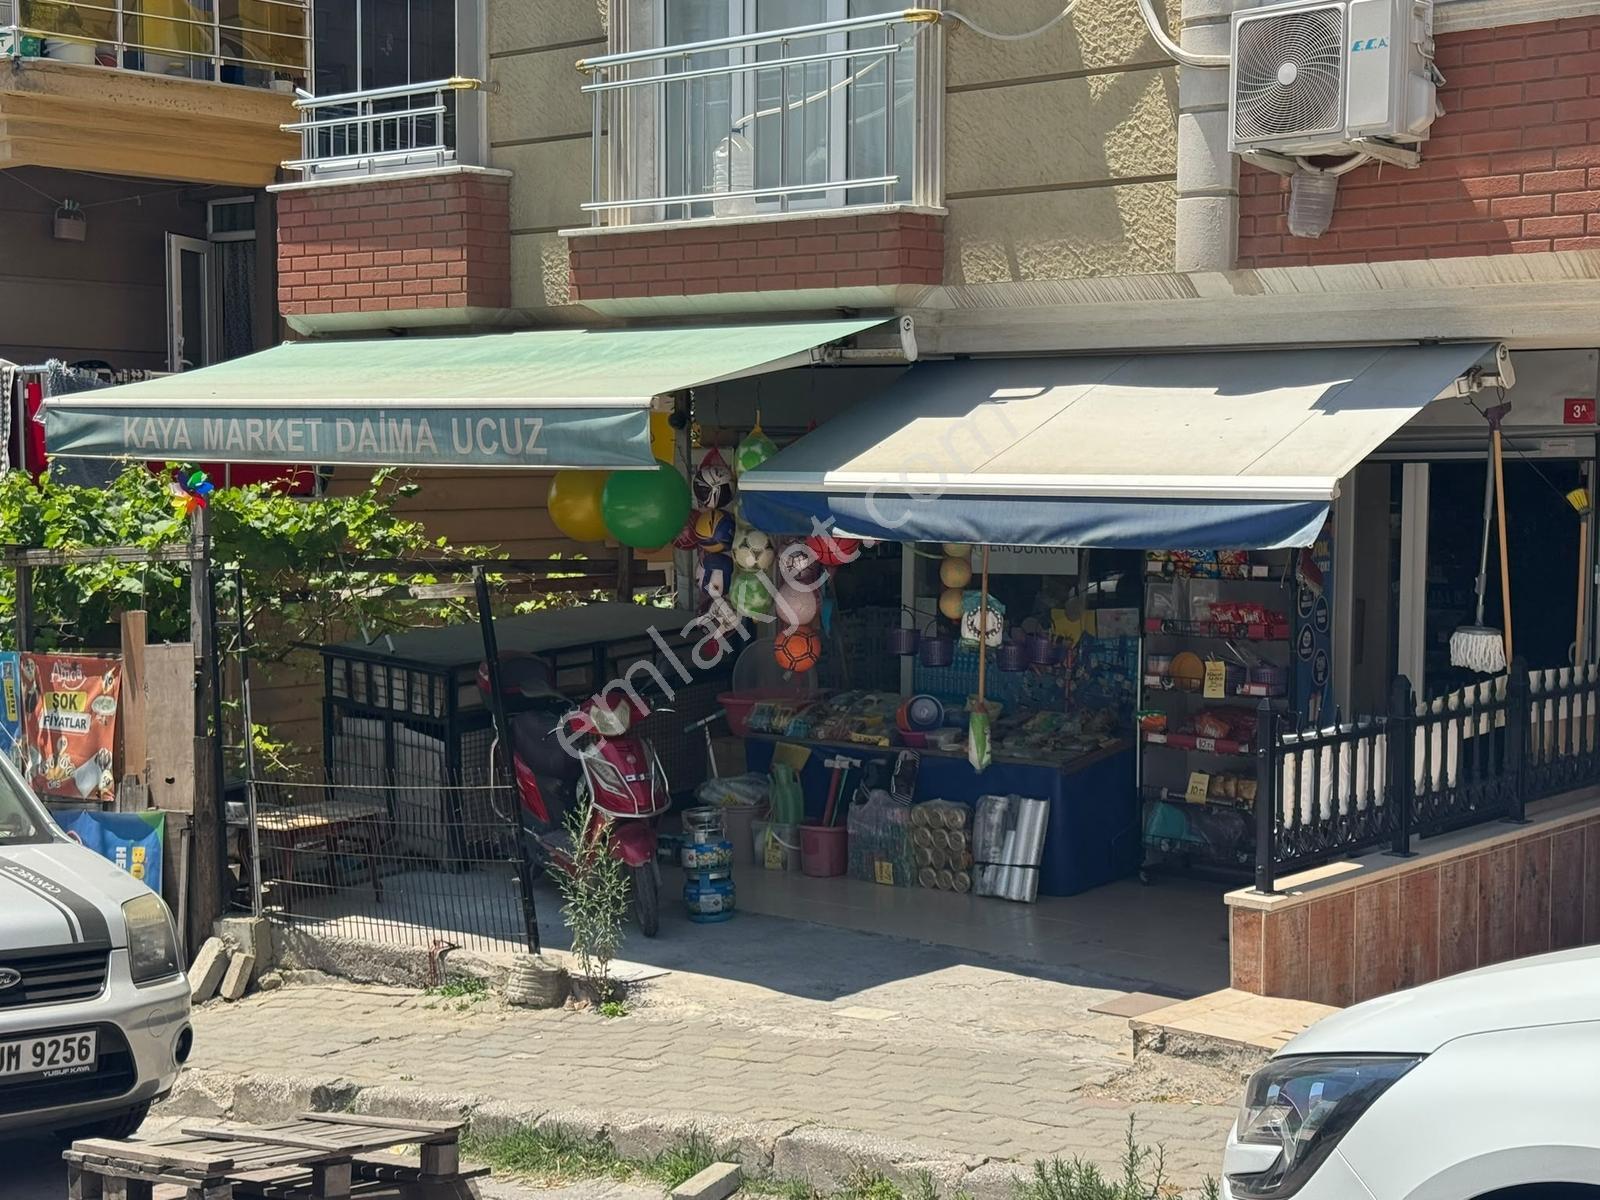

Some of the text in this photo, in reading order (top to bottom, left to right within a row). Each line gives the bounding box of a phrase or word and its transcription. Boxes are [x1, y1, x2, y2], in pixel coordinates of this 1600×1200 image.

[124, 411, 547, 455] KAYA MARKET DAİMA UCUZ
[53, 693, 78, 713] ŞOK
[43, 713, 87, 730] FİYATLAR
[32, 1035, 91, 1068] 9256
